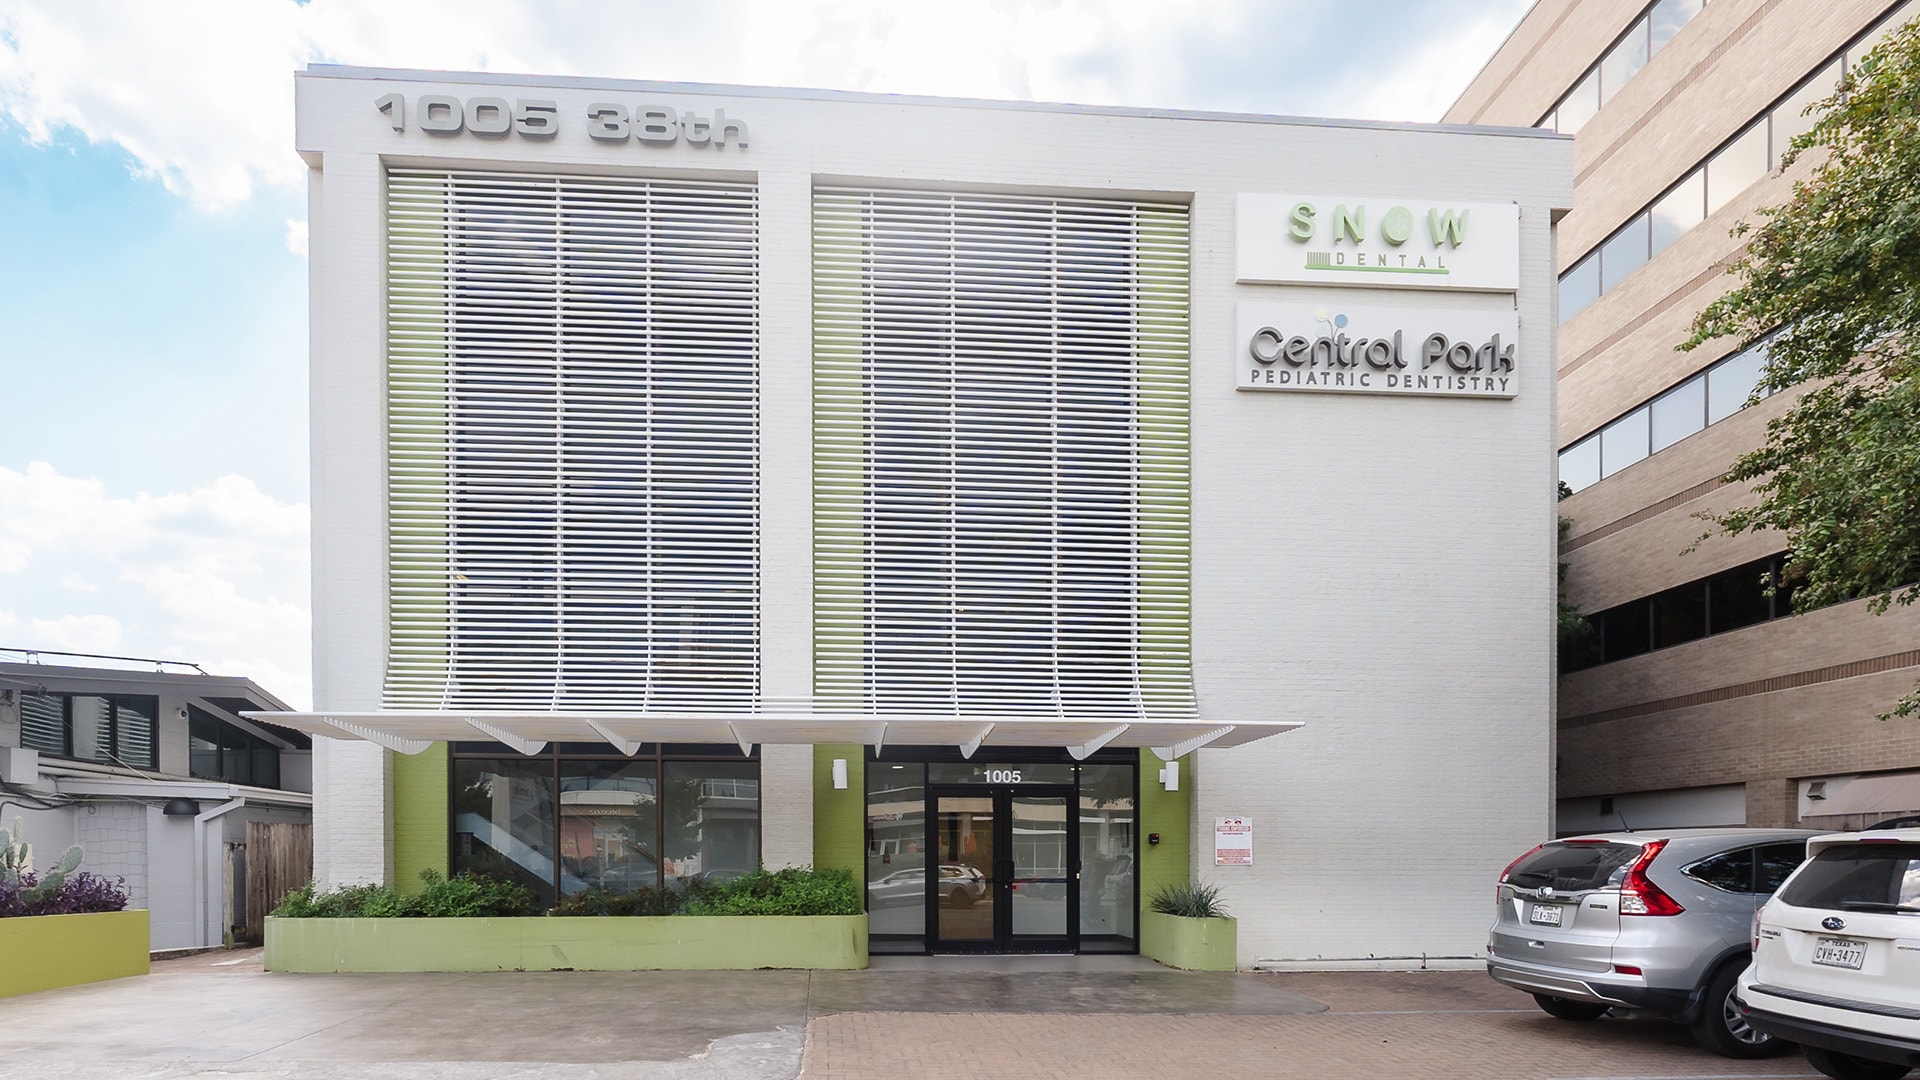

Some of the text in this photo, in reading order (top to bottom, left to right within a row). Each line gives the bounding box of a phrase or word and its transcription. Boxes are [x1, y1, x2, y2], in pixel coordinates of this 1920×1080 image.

[374, 92, 749, 148] 1005 38th
[1288, 201, 1470, 247] SNOW
[1336, 251, 1446, 269] DENTAL
[1250, 326, 1515, 374] Central Park
[1251, 369, 1510, 391] PEDIATRIC DENTISTRY
[983, 769, 1022, 784] 1005
